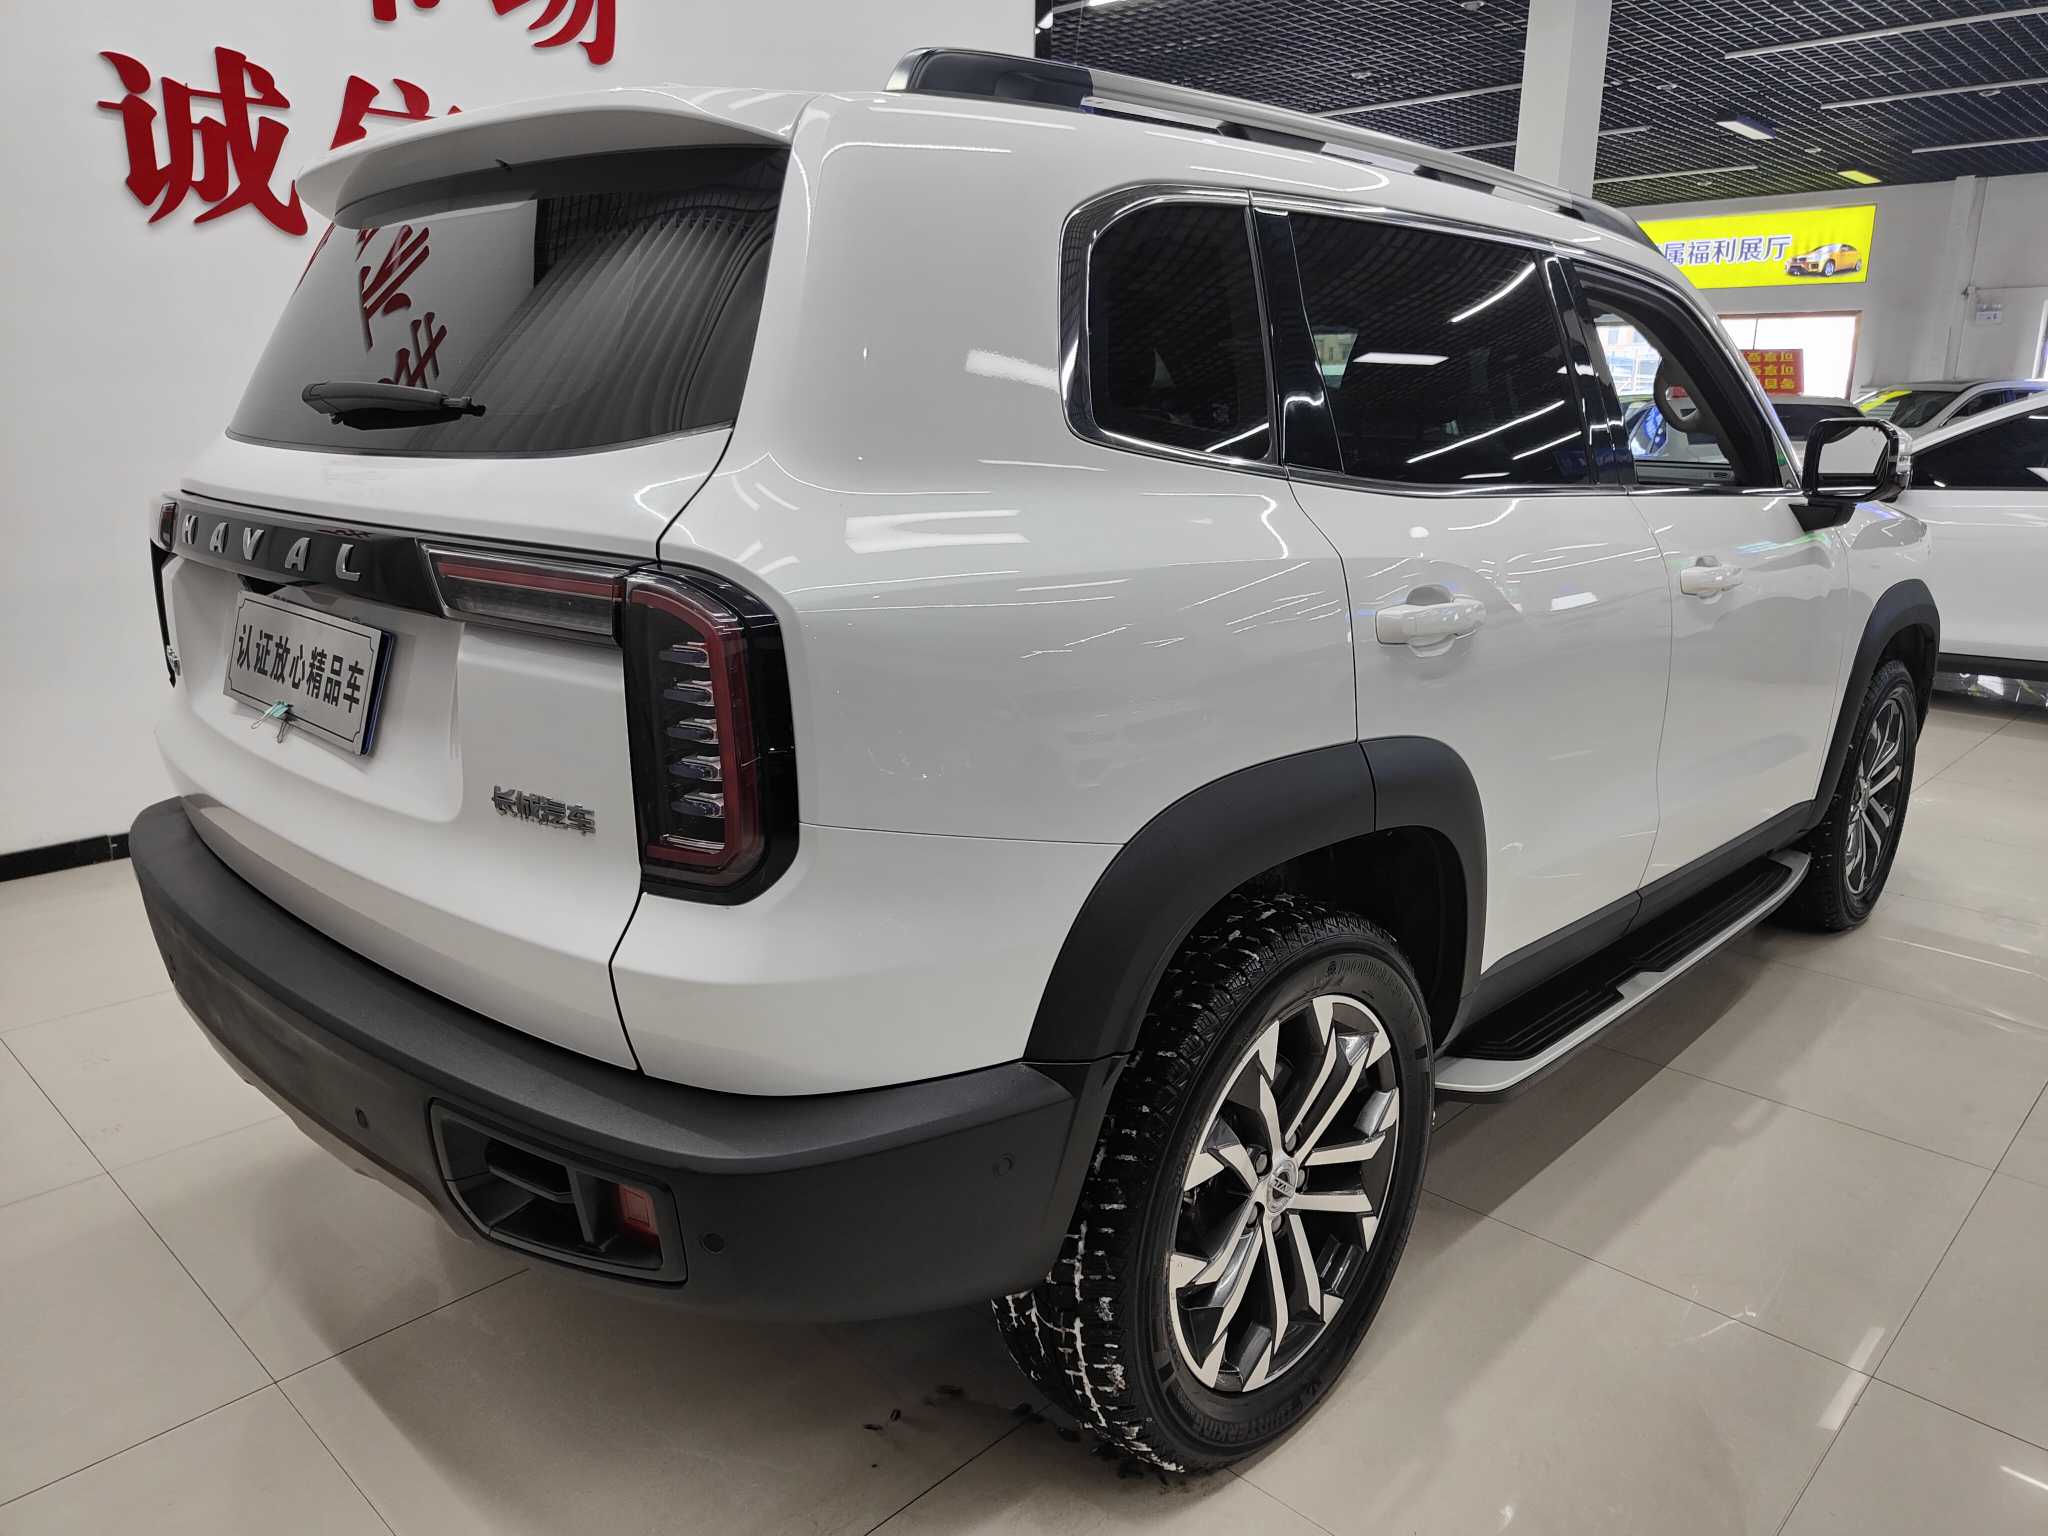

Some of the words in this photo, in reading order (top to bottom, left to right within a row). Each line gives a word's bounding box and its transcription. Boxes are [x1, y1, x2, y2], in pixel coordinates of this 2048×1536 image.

[1656, 234, 1792, 266] 属福利展厅
[181, 513, 361, 582] HAVAL
[236, 623, 365, 713] 认证放心精品车
[491, 785, 596, 837] 长城汽车
